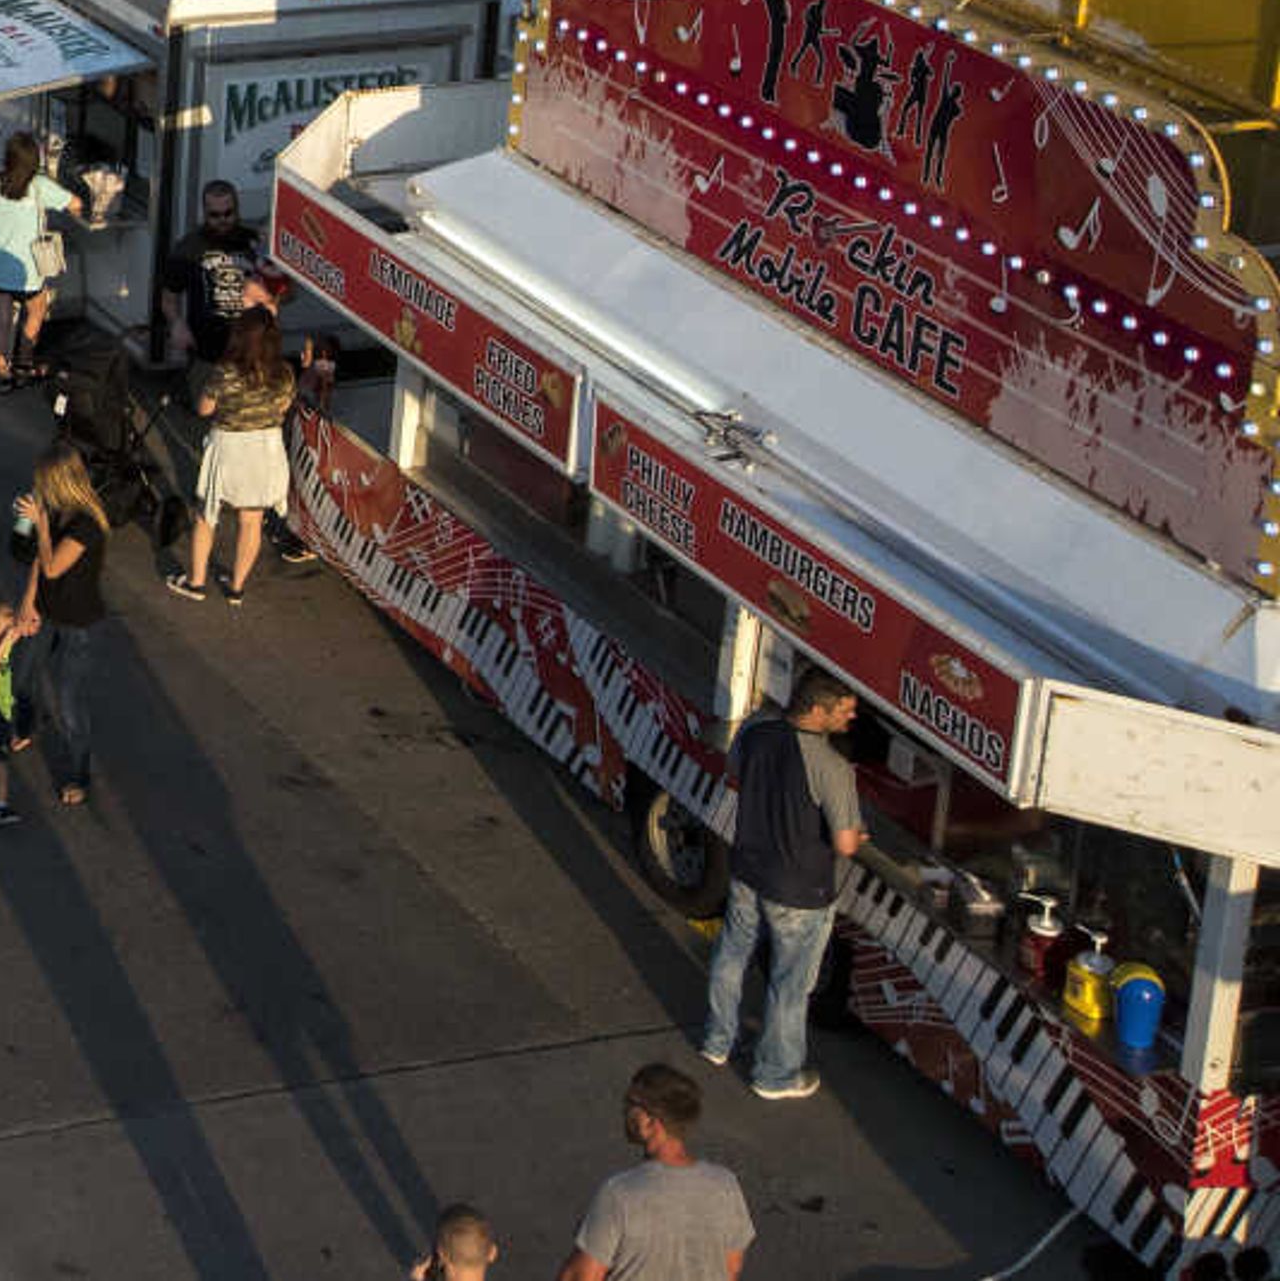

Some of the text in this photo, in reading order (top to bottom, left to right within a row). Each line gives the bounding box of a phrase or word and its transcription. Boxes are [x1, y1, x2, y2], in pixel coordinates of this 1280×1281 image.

[369, 248, 458, 332] LEMONADE
[719, 221, 968, 398] Mobile CAFE
[474, 366, 544, 437] PICKLES
[486, 336, 537, 396] FRIED
[621, 477, 696, 560] CHEESE
[627, 446, 695, 514] PHILLY
[718, 497, 877, 633] HAMBURGERS
[899, 670, 1005, 771] NACHOS
